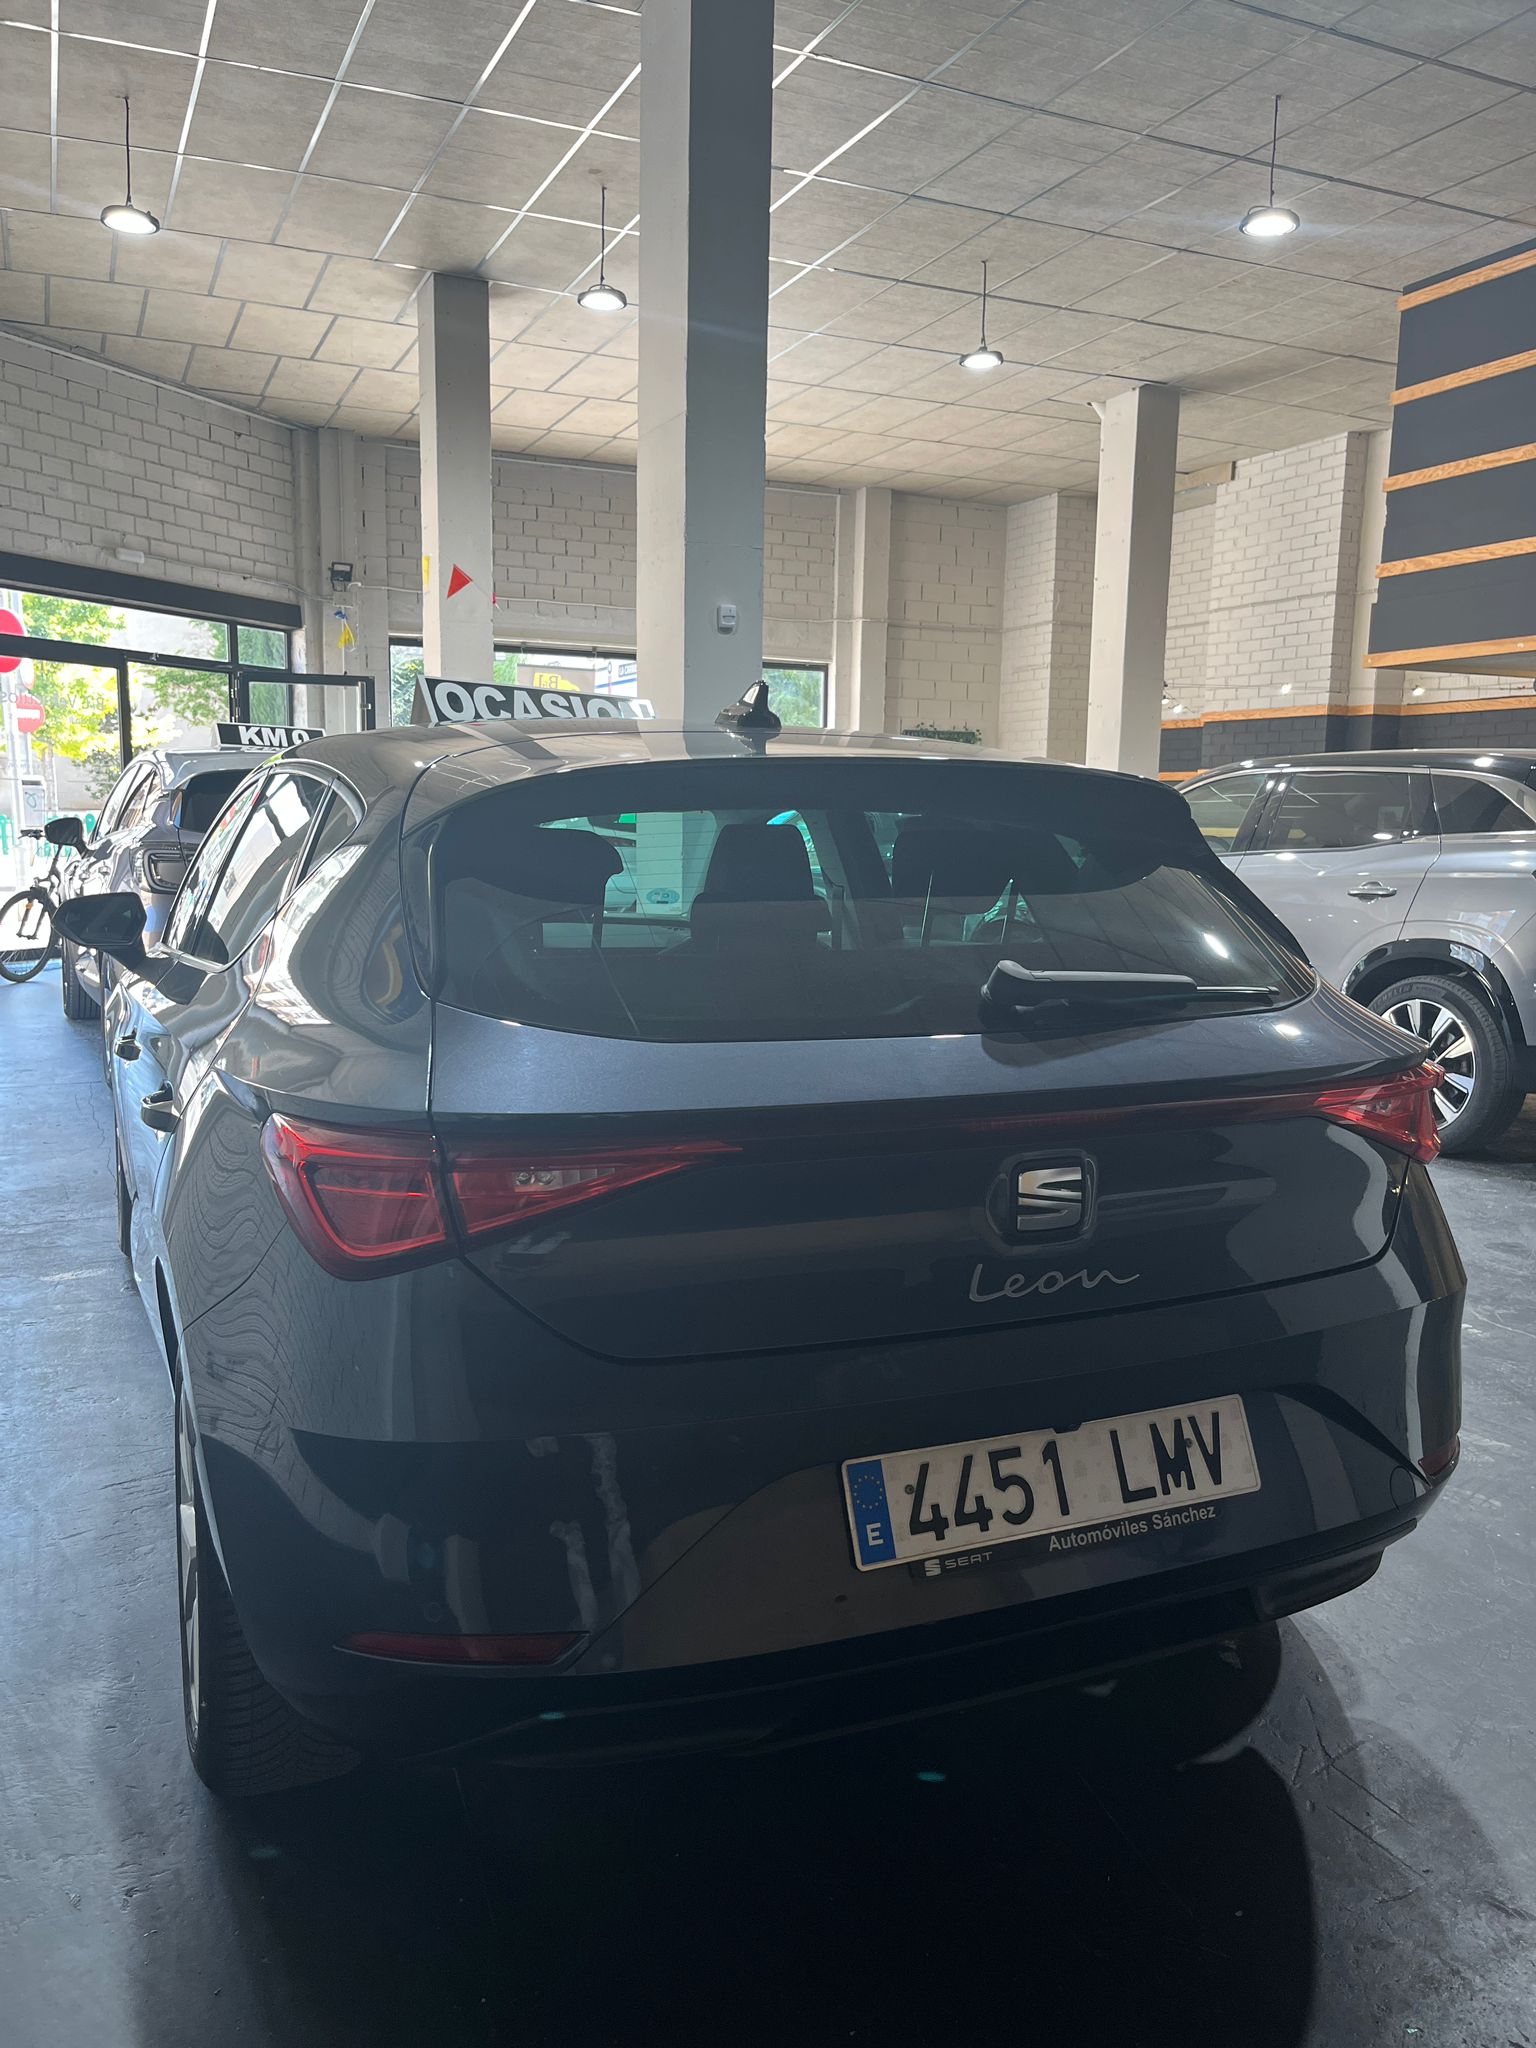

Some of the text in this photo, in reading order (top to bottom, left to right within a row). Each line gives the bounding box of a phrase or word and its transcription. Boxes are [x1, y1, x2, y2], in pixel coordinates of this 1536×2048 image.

[238, 726, 289, 747] KM
[969, 1263, 1140, 1303] Leon
[908, 1411, 1223, 1541] 4451 LMV
[865, 1522, 885, 1547] E
[1048, 1504, 1217, 1552] Automóviles Sánchez
[943, 1551, 993, 1570] SEAT
